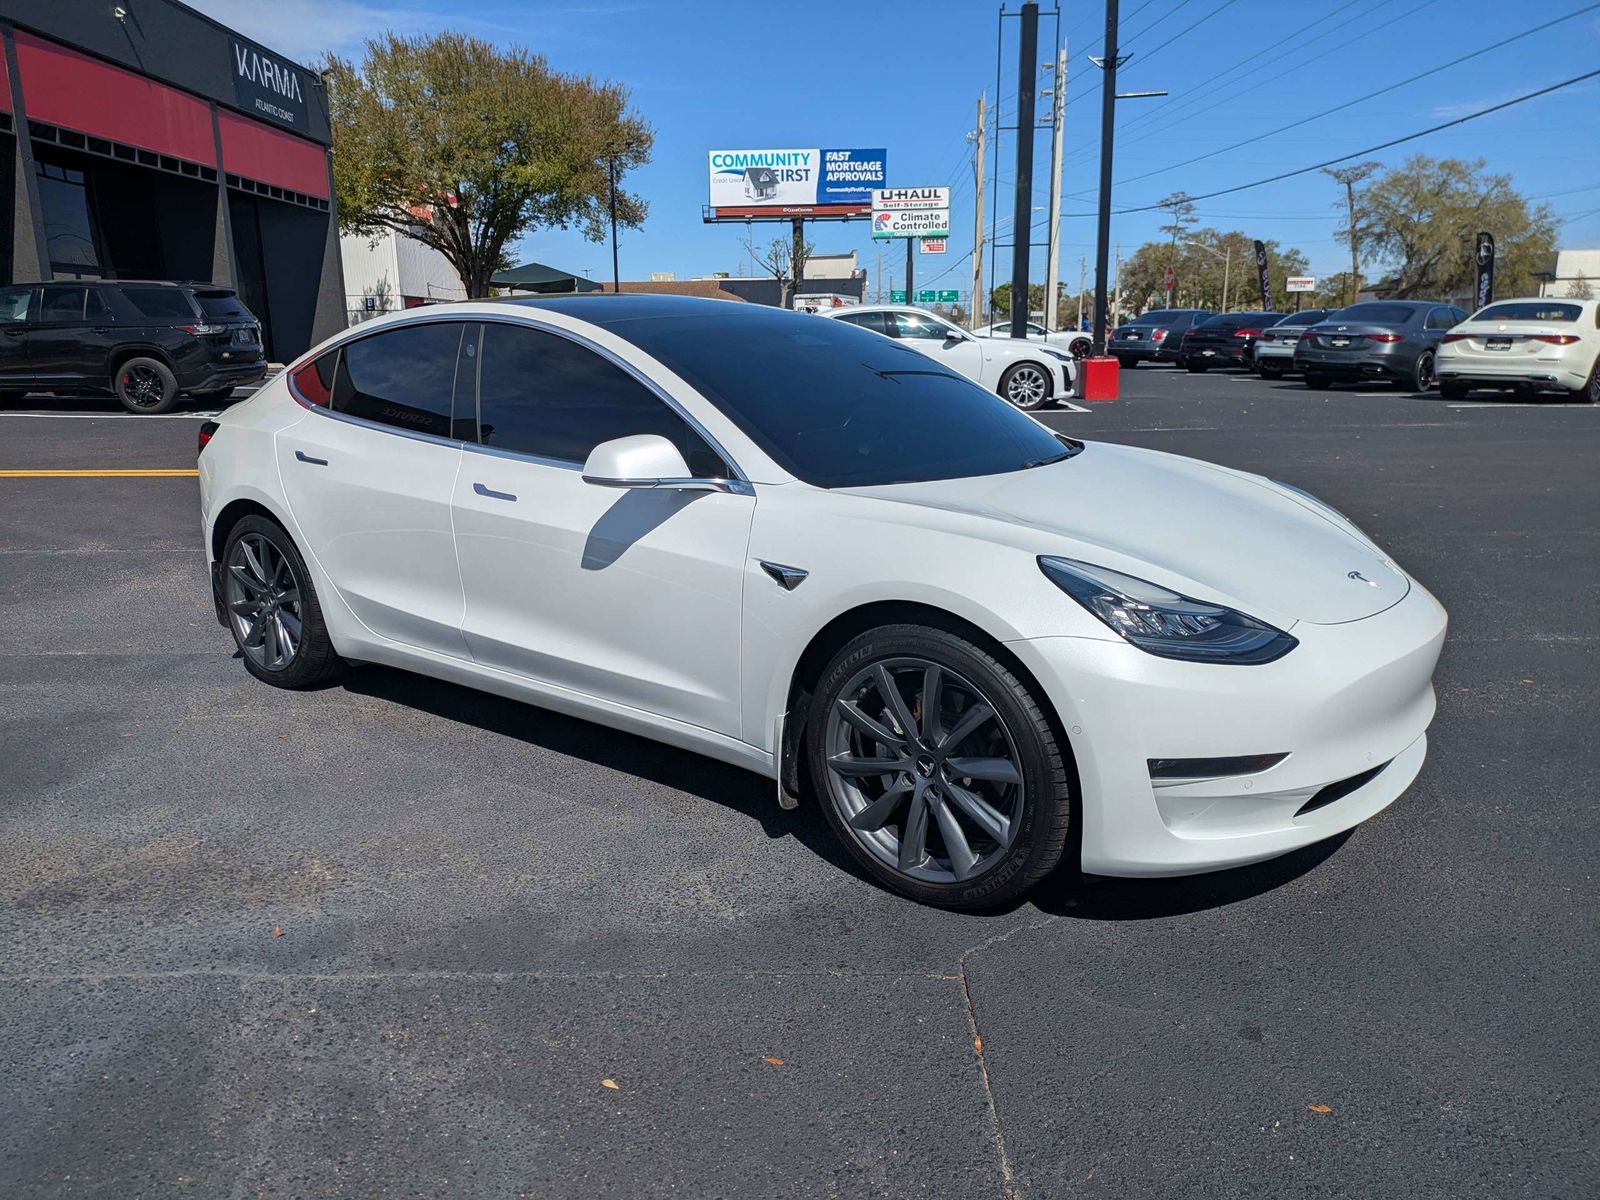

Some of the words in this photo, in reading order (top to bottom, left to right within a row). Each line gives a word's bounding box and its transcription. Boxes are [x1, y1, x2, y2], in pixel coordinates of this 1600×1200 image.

[235, 43, 302, 103] KARMA
[712, 153, 810, 167] COMMUNITY
[826, 151, 851, 161] FAST
[826, 161, 882, 171] MORTGAGE
[826, 171, 884, 181] APPROVALS
[900, 213, 941, 221] Climate
[893, 221, 948, 230] Controlled
